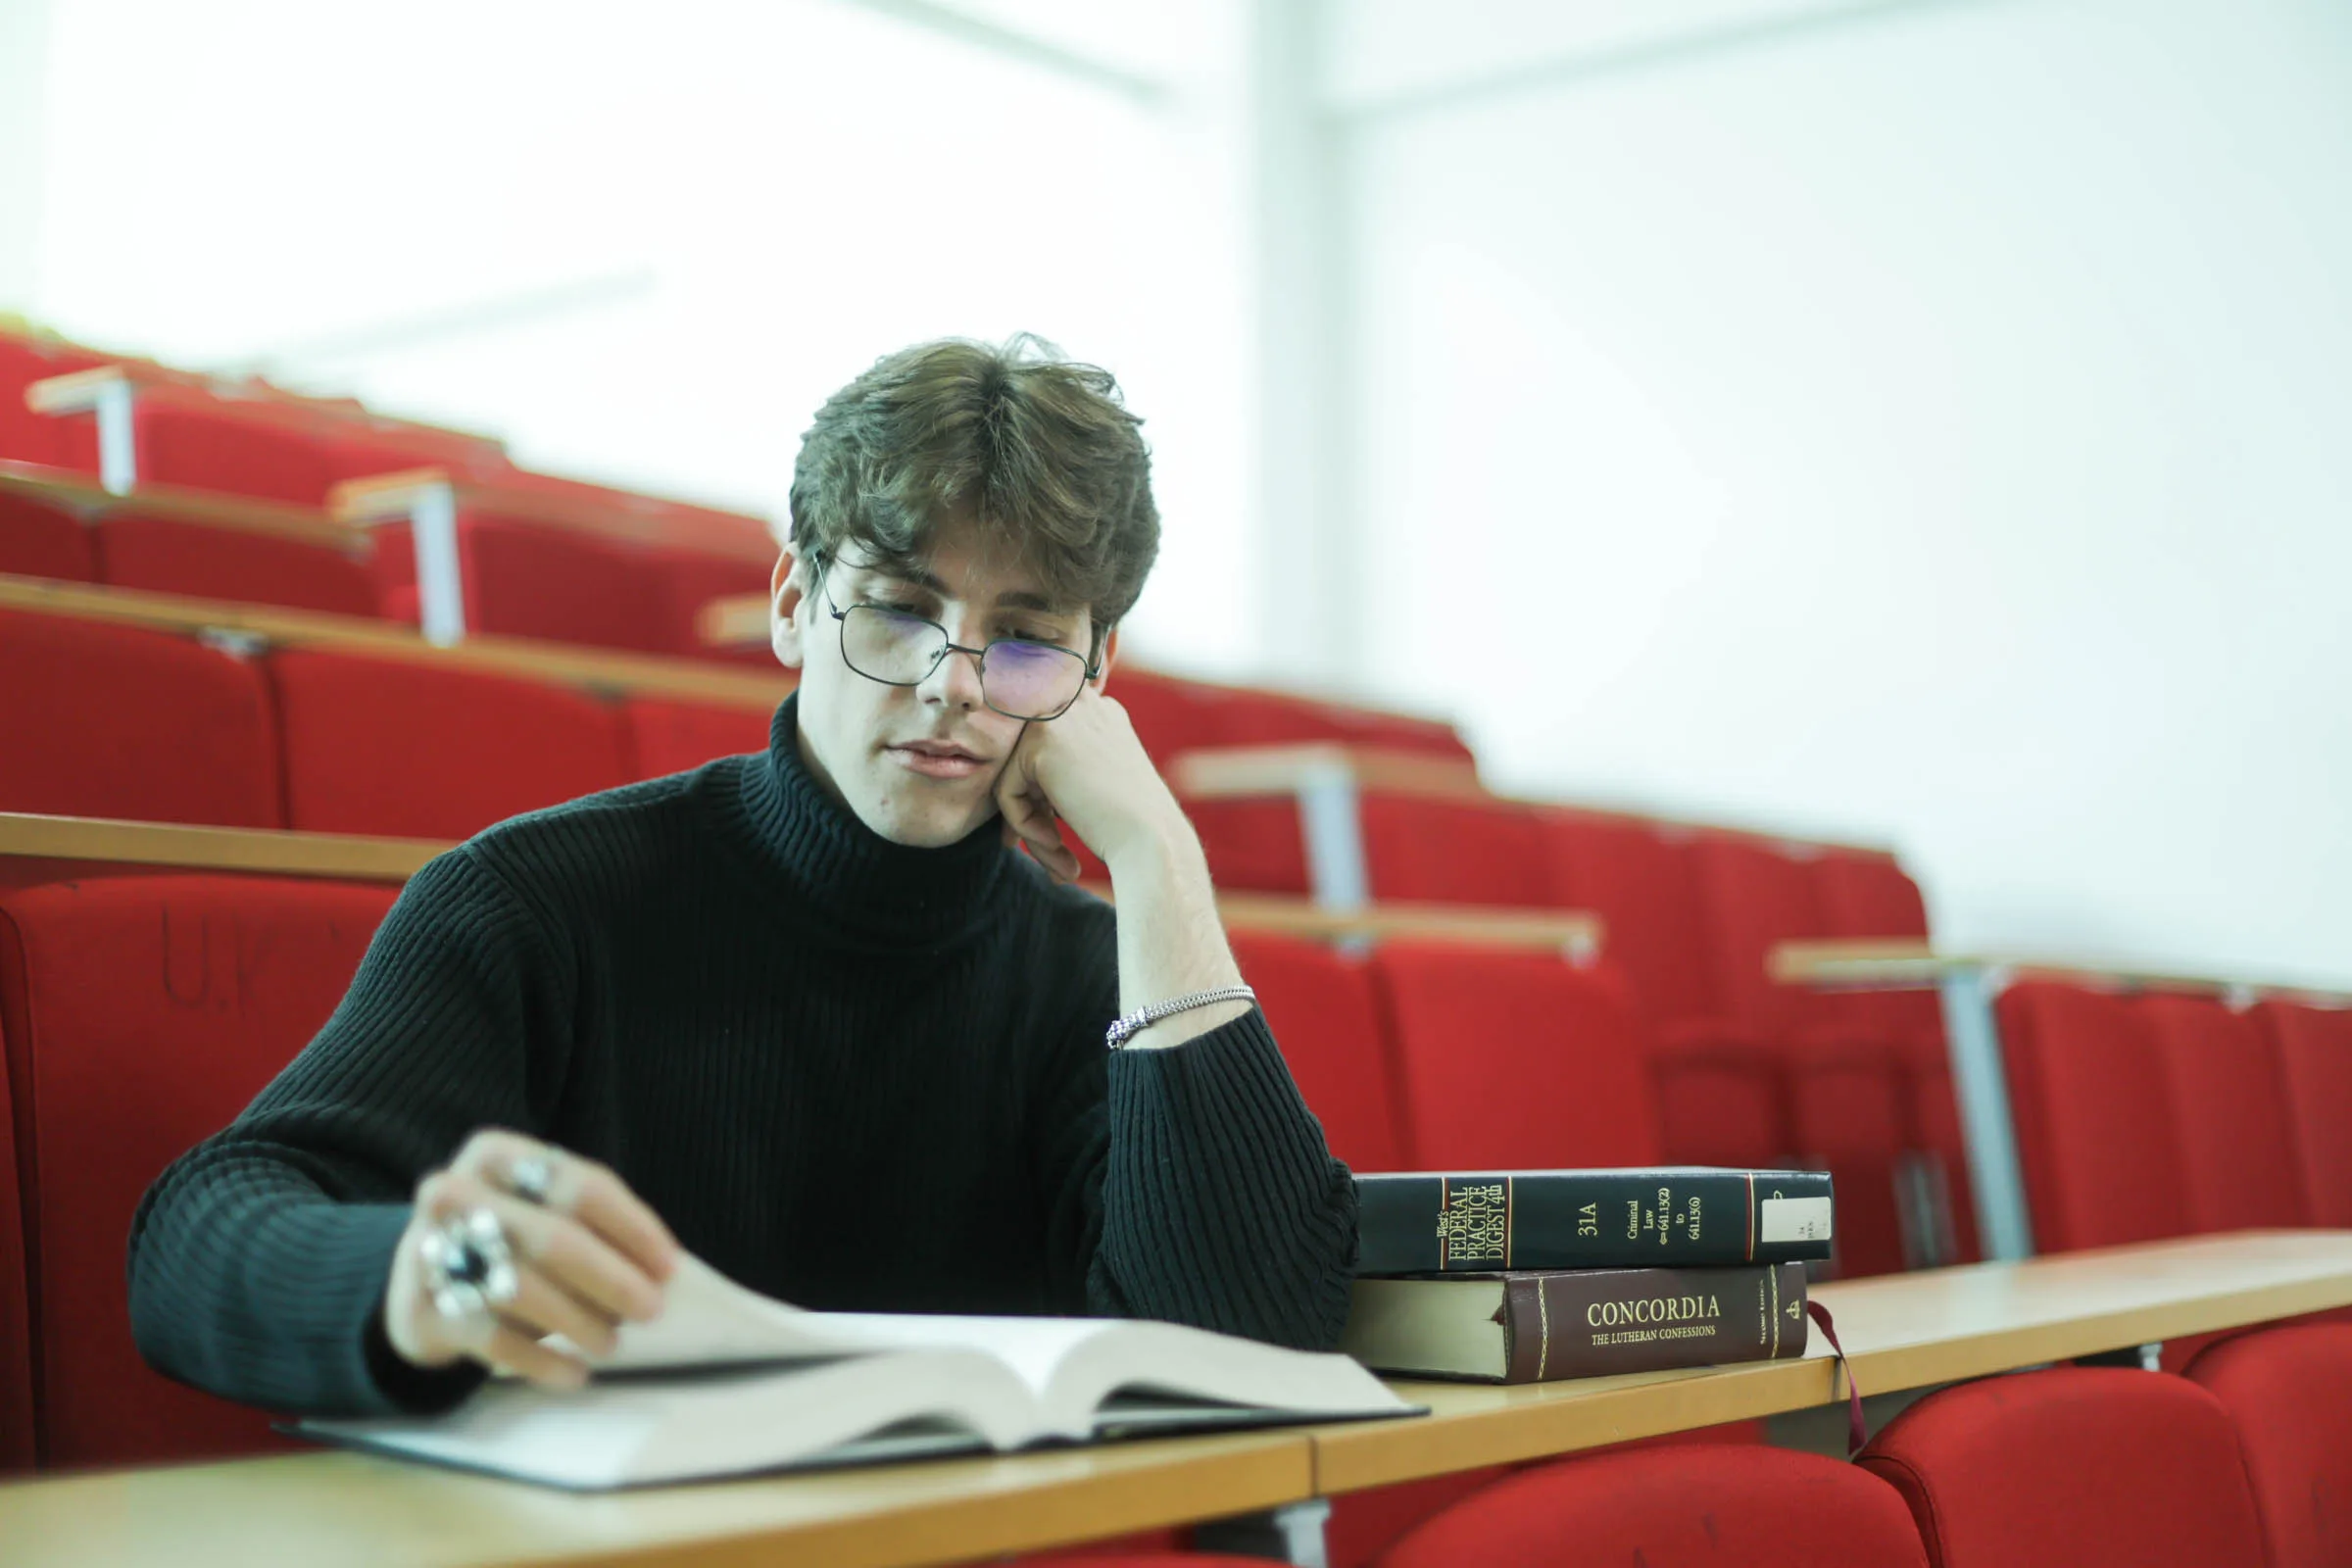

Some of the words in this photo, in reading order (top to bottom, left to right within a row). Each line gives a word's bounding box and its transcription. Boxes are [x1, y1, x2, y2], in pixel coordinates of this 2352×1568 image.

[1486, 1184, 1505, 1204] 4th
[1657, 1187, 1670, 1231] 641.13(2)
[1437, 1210, 1449, 1238] West's
[1448, 1187, 1468, 1260] FEDERAL
[1467, 1186, 1487, 1261] PRACTICE
[1486, 1205, 1505, 1260] DIGEST
[1578, 1201, 1598, 1237] 31A
[1627, 1200, 1639, 1240] Criminal
[1643, 1209, 1653, 1230] Law
[1675, 1213, 1685, 1224] to
[1688, 1197, 1701, 1240] 641.13(6)
[1587, 1295, 1721, 1327] CONCORDIA
[1592, 1334, 1609, 1346] THE
[1611, 1329, 1657, 1344] LUTHERAN
[1659, 1325, 1716, 1340] CONFESSIONS
